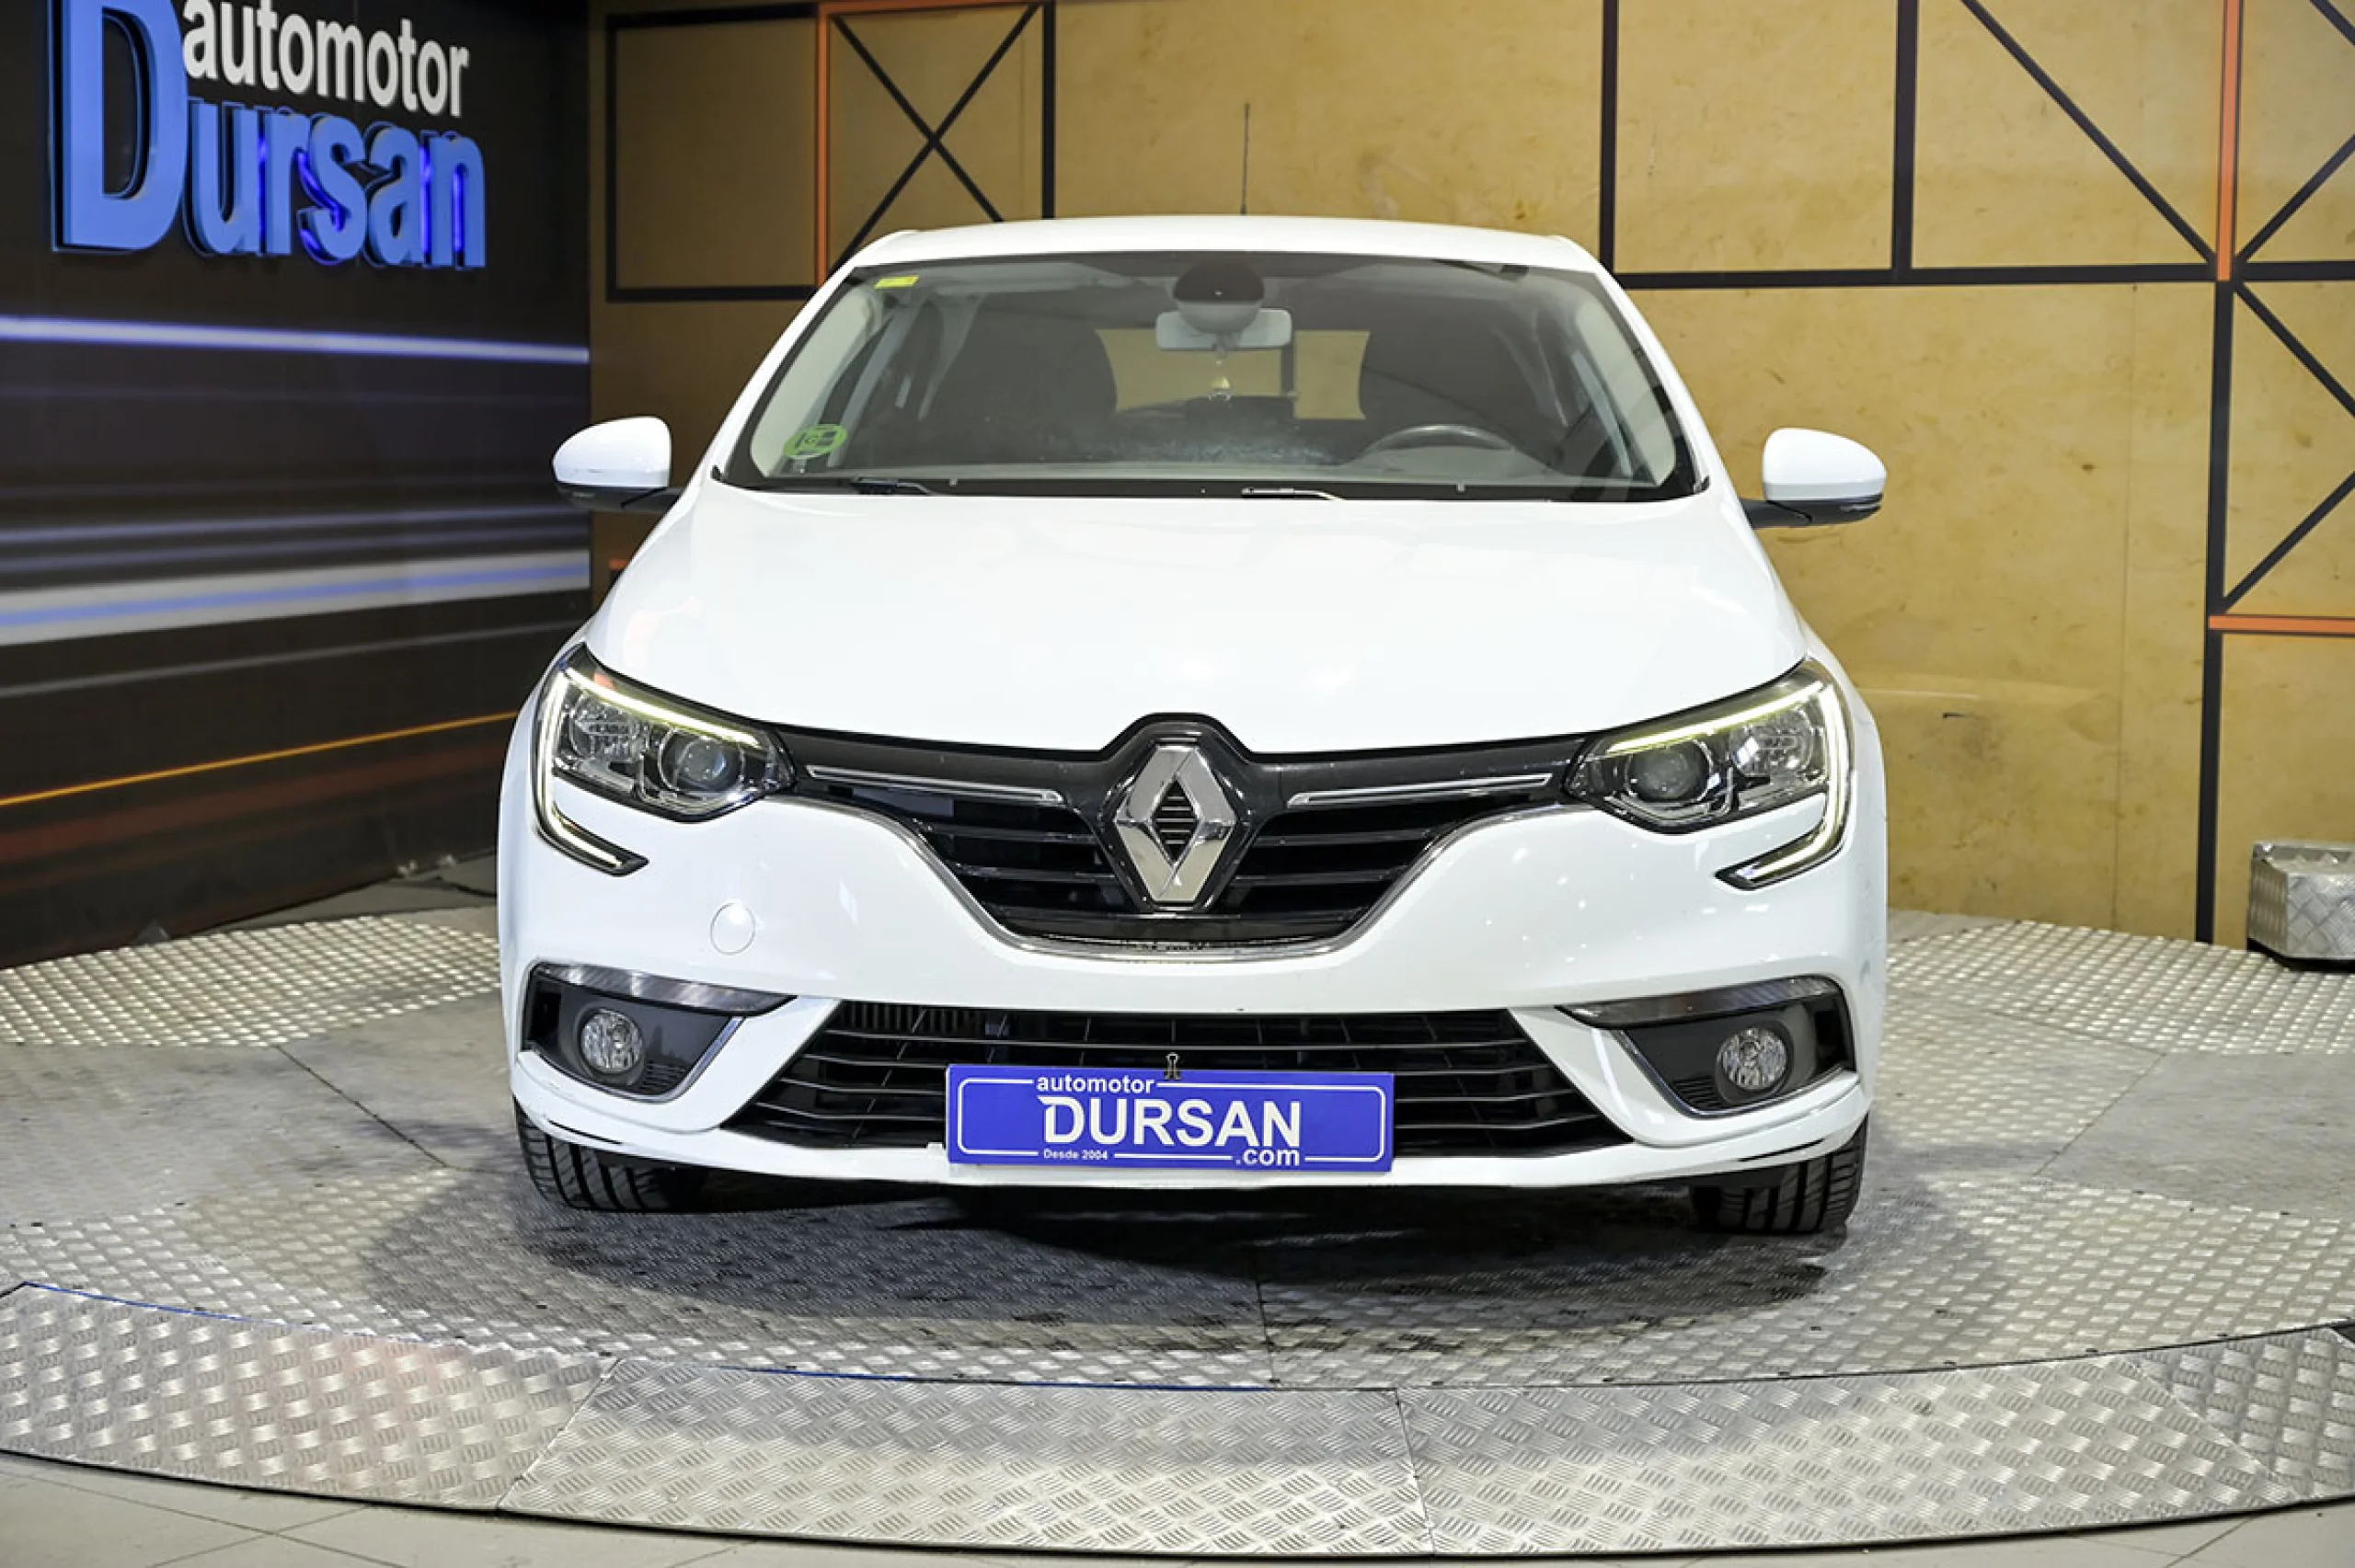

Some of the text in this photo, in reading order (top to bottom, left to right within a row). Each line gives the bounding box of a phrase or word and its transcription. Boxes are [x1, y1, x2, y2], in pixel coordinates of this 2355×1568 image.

[183, 0, 469, 117] automotor
[51, 0, 486, 269] Dursan
[1036, 1073, 1155, 1094] automotor
[1037, 1094, 1301, 1148] DURSAN
[1043, 1148, 1108, 1161] Desde 2004
[1235, 1148, 1301, 1167] .com
